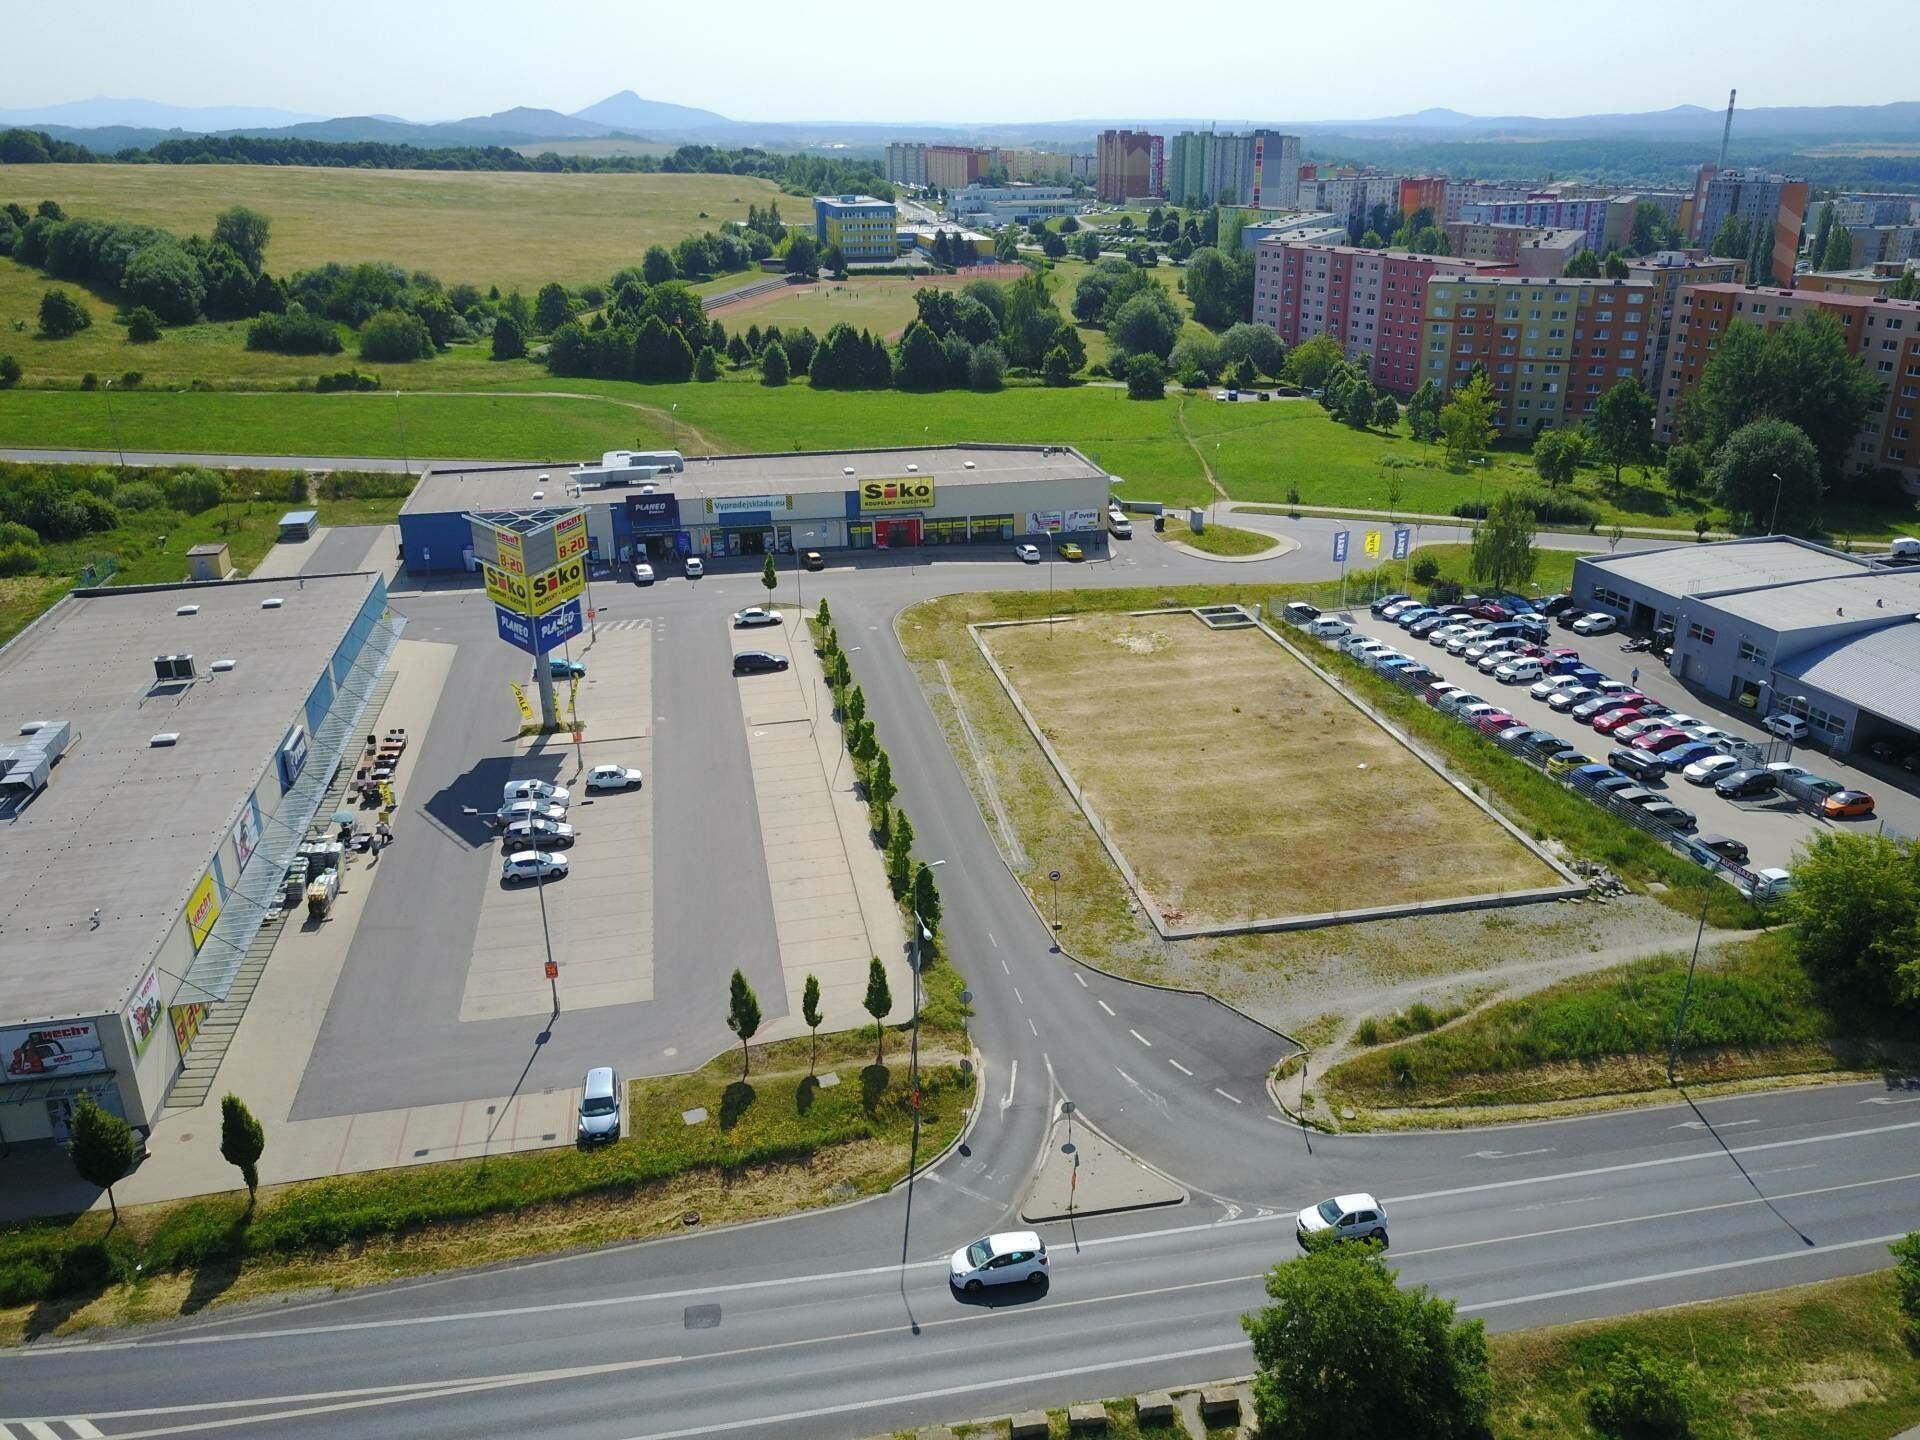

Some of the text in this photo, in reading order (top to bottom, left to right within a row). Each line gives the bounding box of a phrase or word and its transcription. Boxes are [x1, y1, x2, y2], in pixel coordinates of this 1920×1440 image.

[635, 503, 666, 511] PLANEO
[559, 536, 586, 559] 8-20
[501, 615, 529, 638] PLANEO
[514, 691, 529, 713] SALE
